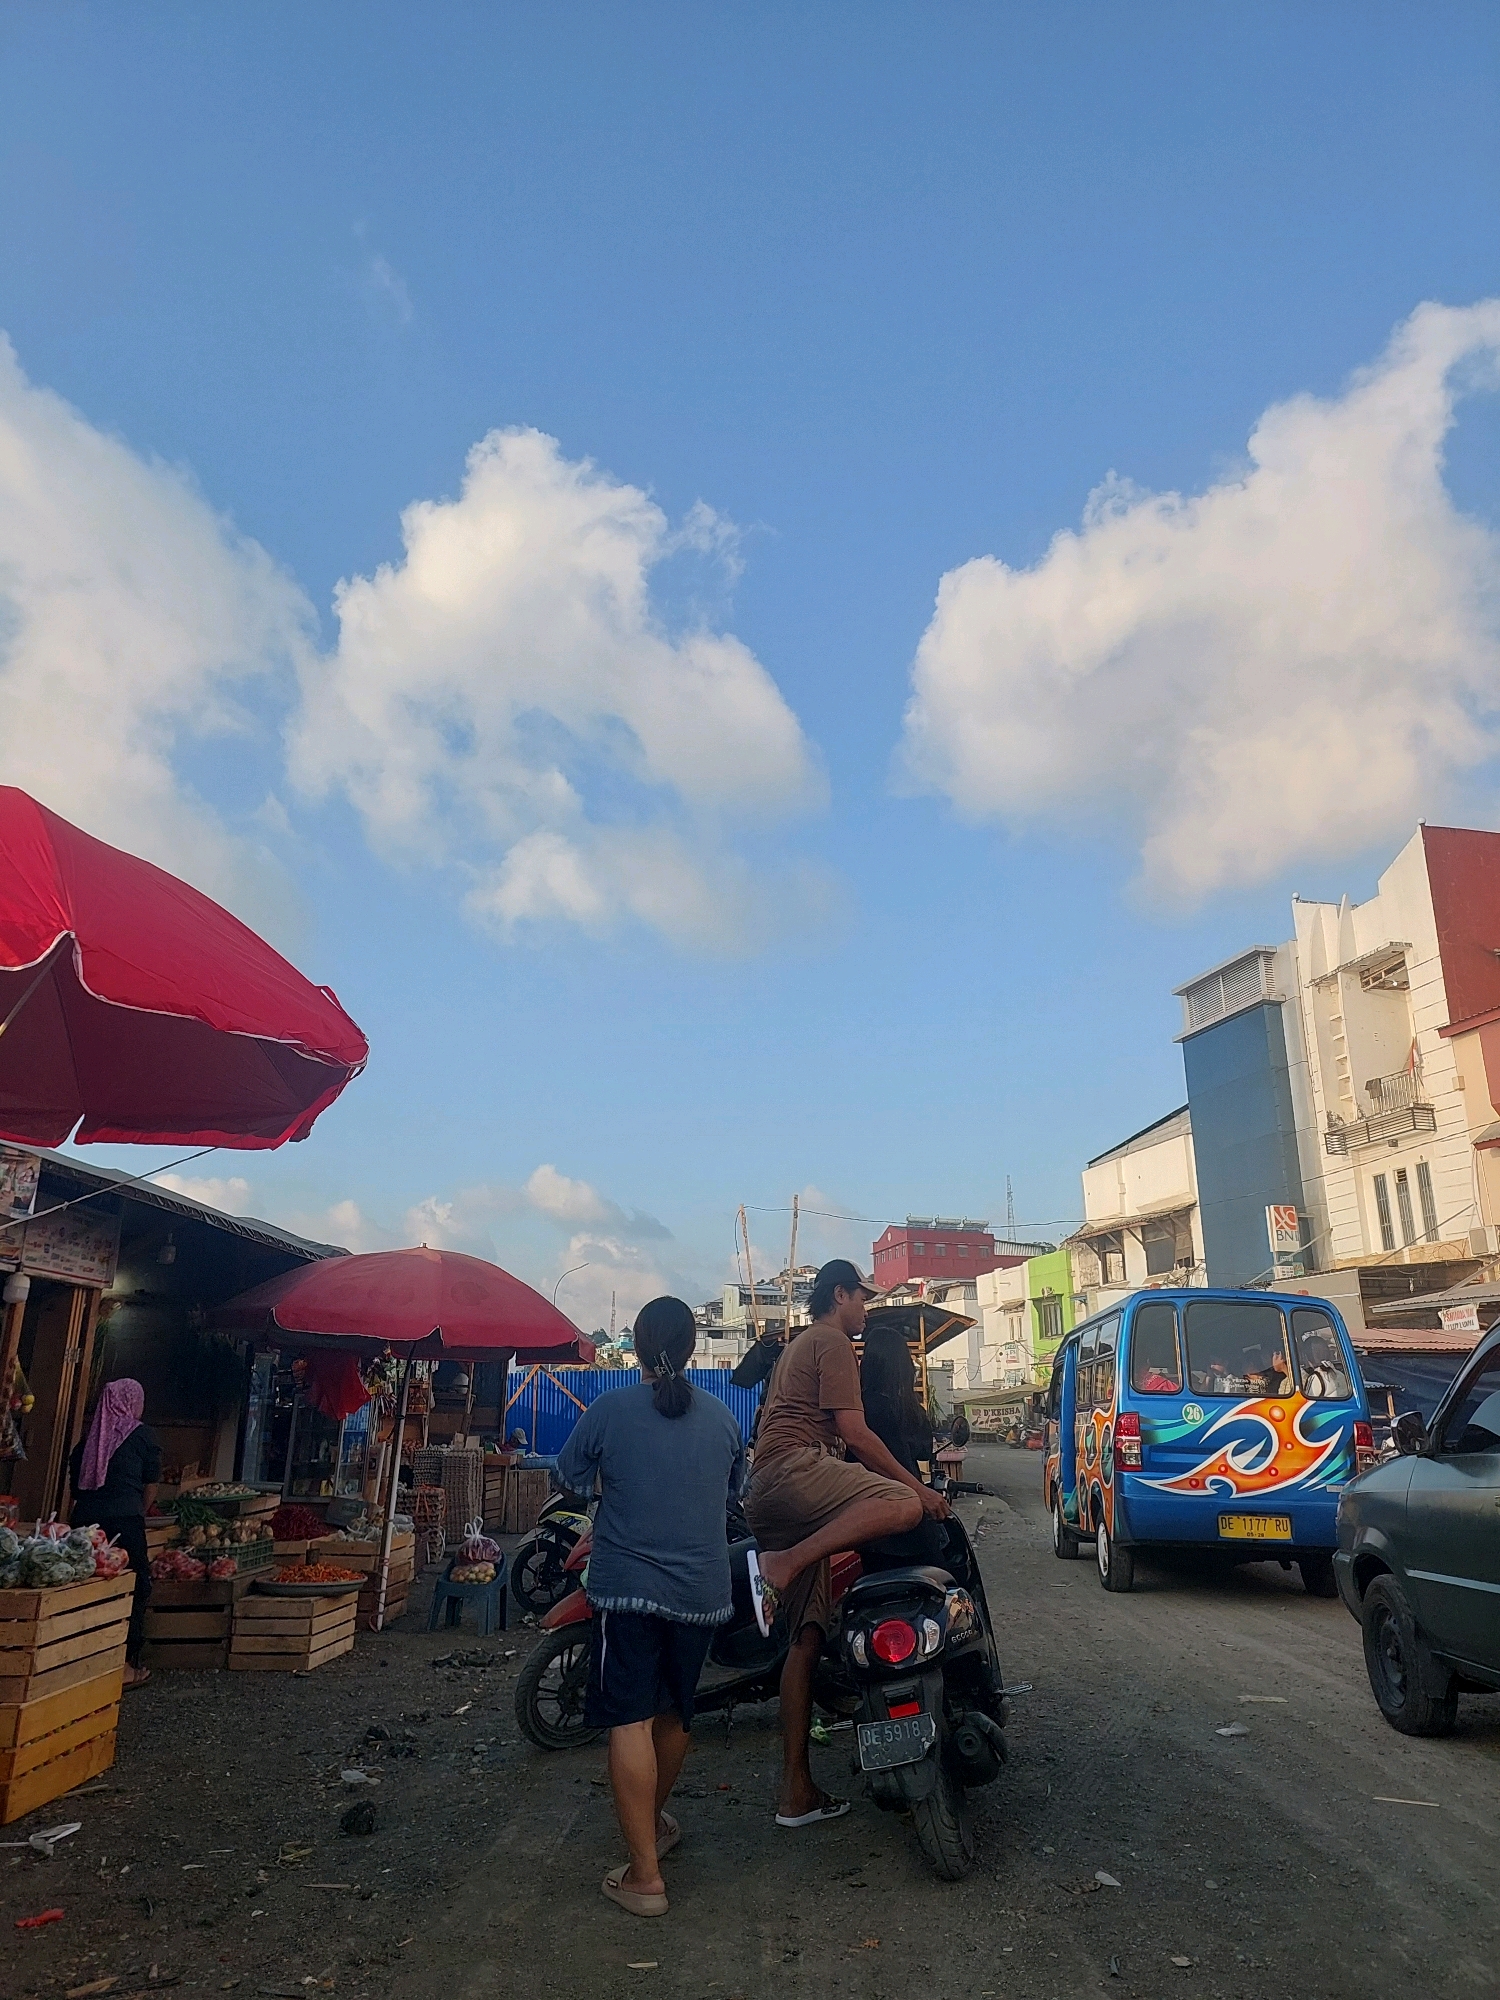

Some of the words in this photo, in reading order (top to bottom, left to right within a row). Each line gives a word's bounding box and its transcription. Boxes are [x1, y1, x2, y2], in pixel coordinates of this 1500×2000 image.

[983, 1406, 1021, 1417] D'KEISHA
[1187, 1406, 1200, 1420] 26
[1221, 1517, 1234, 1530] DE
[1243, 1518, 1267, 1531] 1177
[1275, 1519, 1288, 1532] RU
[861, 1727, 881, 1746] DE
[884, 1720, 920, 1742] 5918
